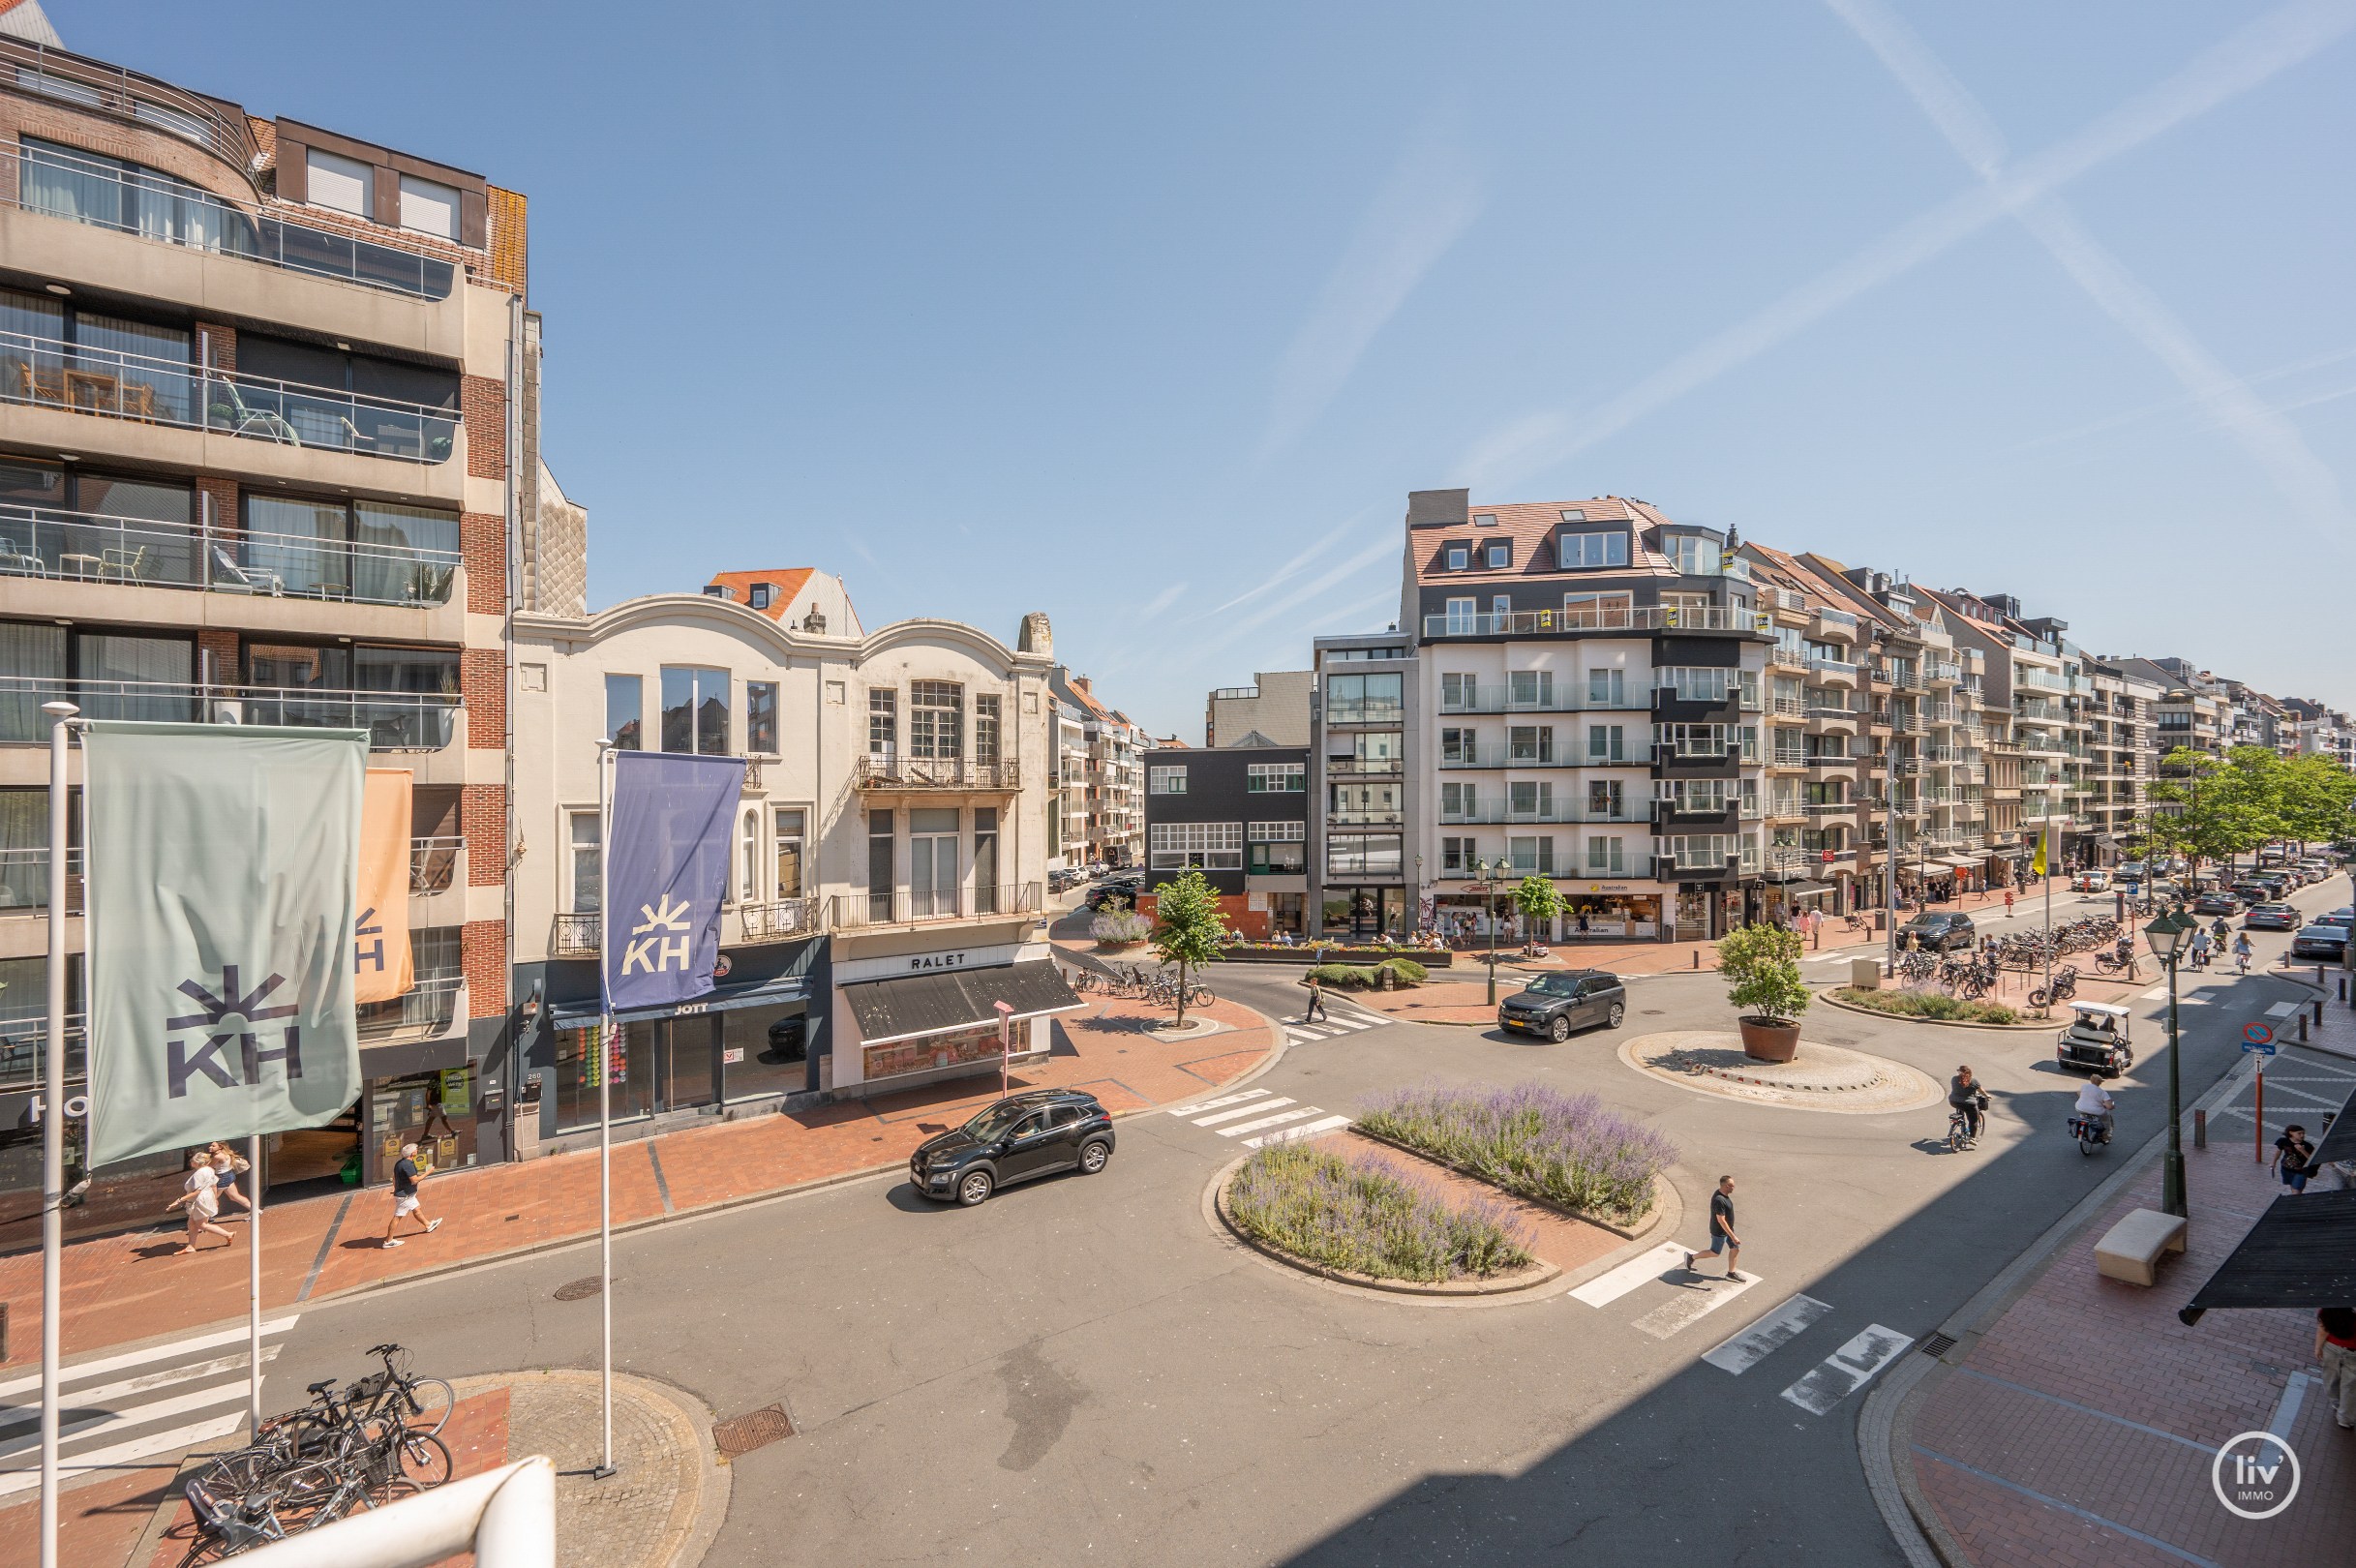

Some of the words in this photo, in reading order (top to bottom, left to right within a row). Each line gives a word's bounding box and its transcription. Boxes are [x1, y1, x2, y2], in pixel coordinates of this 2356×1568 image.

[2129, 885, 2136, 893] P
[354, 939, 384, 974] H
[620, 935, 690, 976] KH
[912, 953, 964, 969] RALET
[674, 1002, 709, 1016] JOTT
[166, 1026, 302, 1100] KH
